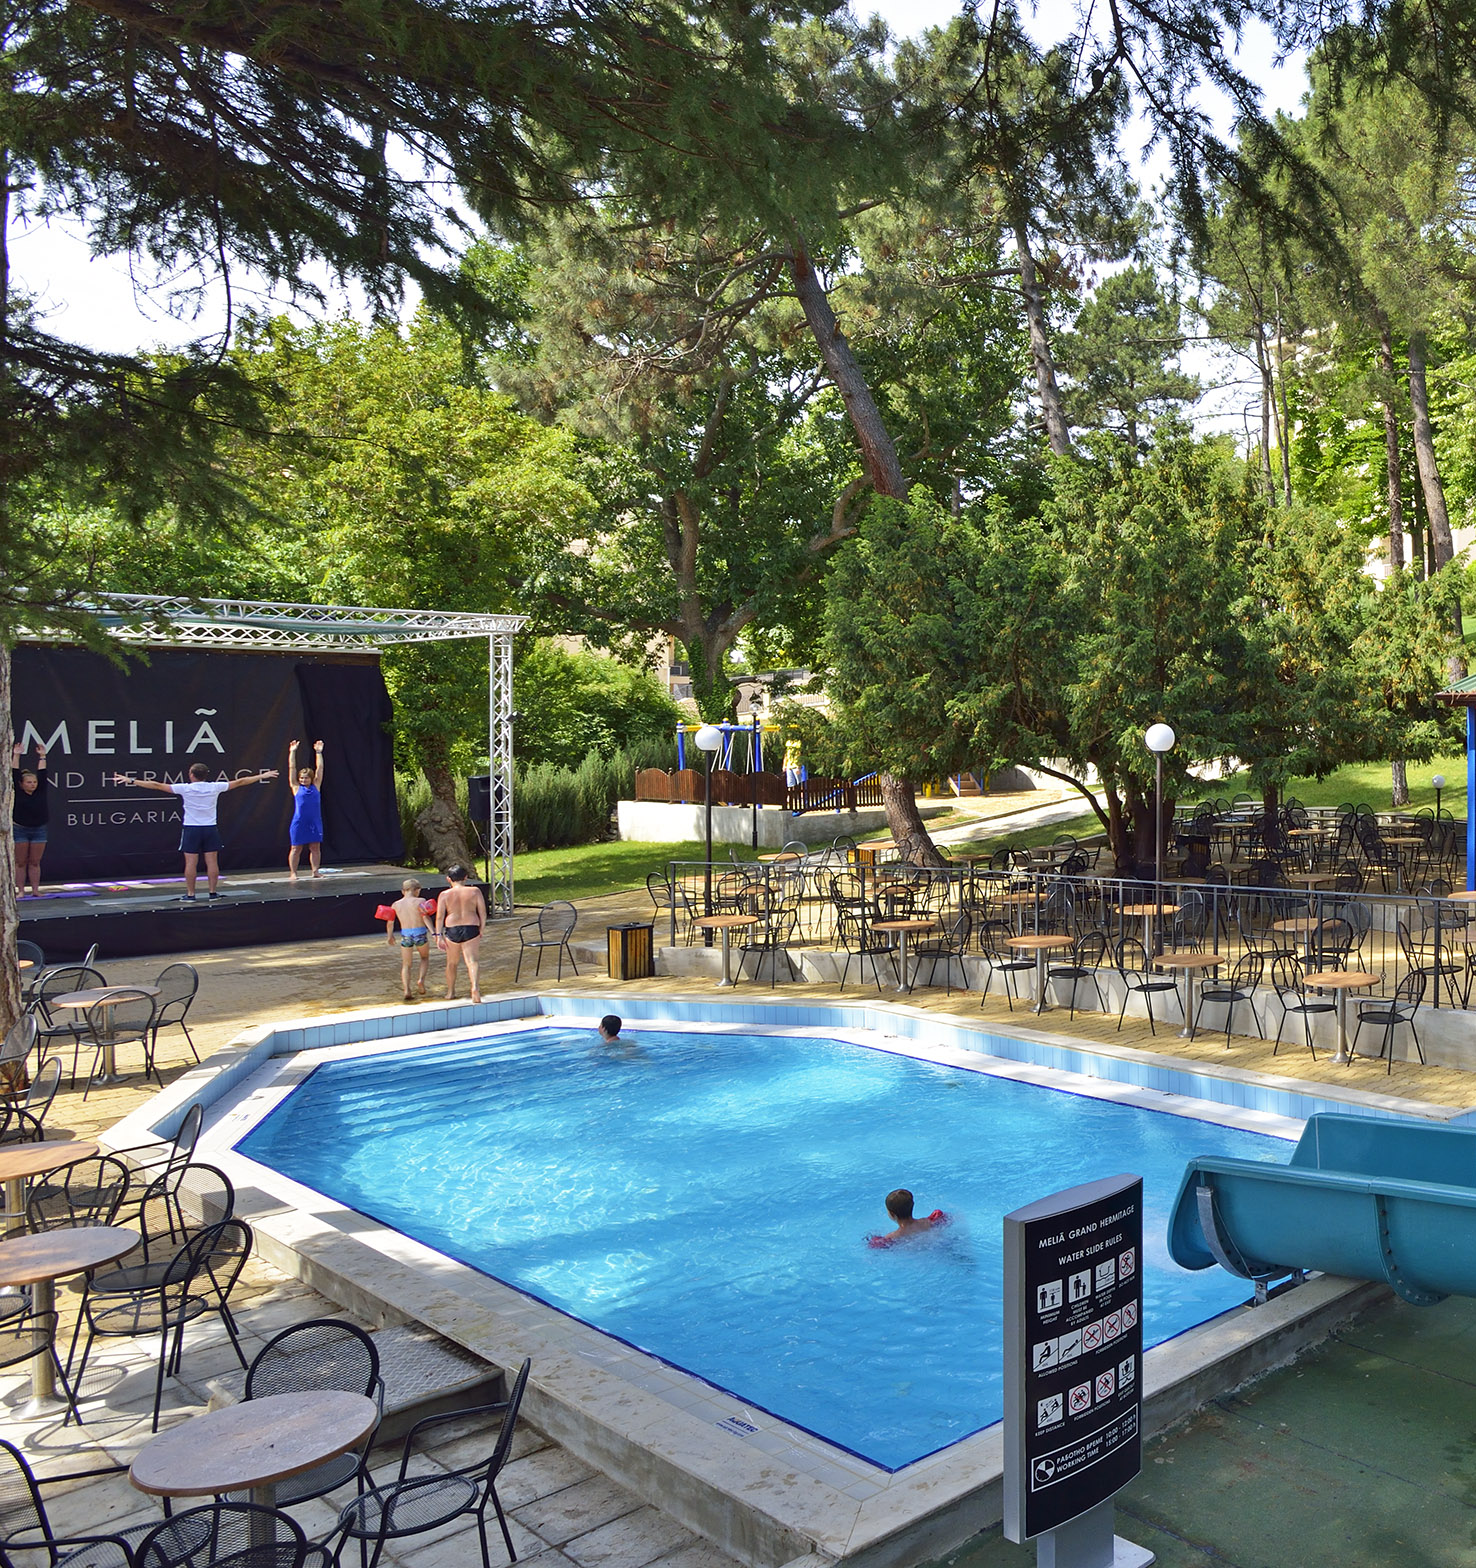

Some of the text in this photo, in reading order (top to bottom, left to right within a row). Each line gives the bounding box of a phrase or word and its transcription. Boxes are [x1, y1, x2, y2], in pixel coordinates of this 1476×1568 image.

[21, 708, 225, 754] MELIÃ
[102, 768, 271, 787] HERMAGE
[67, 811, 182, 827] BULGARIA
[1068, 1222, 1097, 1239] GRAND
[1100, 1205, 1135, 1228] HERMITAGE
[1058, 1233, 1122, 1265] WATER SLIDE RULES
[1046, 1421, 1066, 1433] DISTANCE
[1056, 1446, 1085, 1464] РАБОТНО
[1056, 1454, 1086, 1473] WORKING
[1087, 1447, 1099, 1458] TIME
